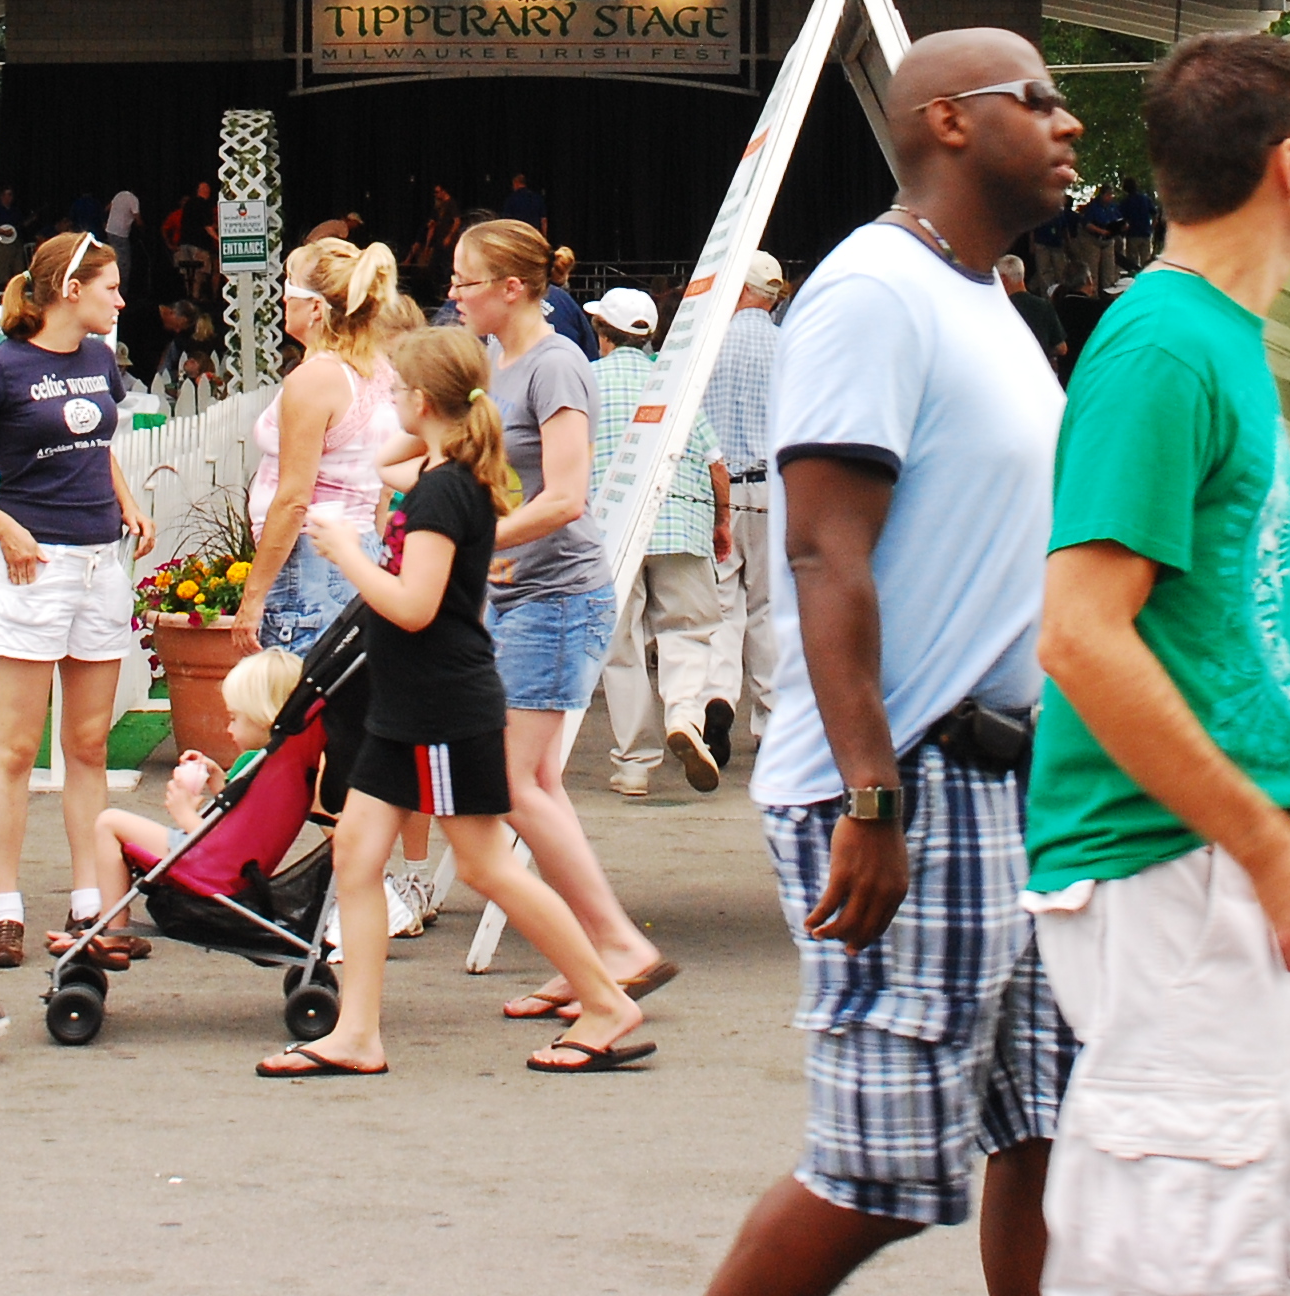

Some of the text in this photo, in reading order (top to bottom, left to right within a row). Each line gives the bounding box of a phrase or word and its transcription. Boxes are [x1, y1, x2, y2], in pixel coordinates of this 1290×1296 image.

[323, 1, 729, 39] TIPPERARY STAGE
[321, 47, 731, 61] MILWAUKEE IRISH FEST
[222, 241, 265, 255] ENTRANCE
[30, 373, 110, 401] celtic woman
